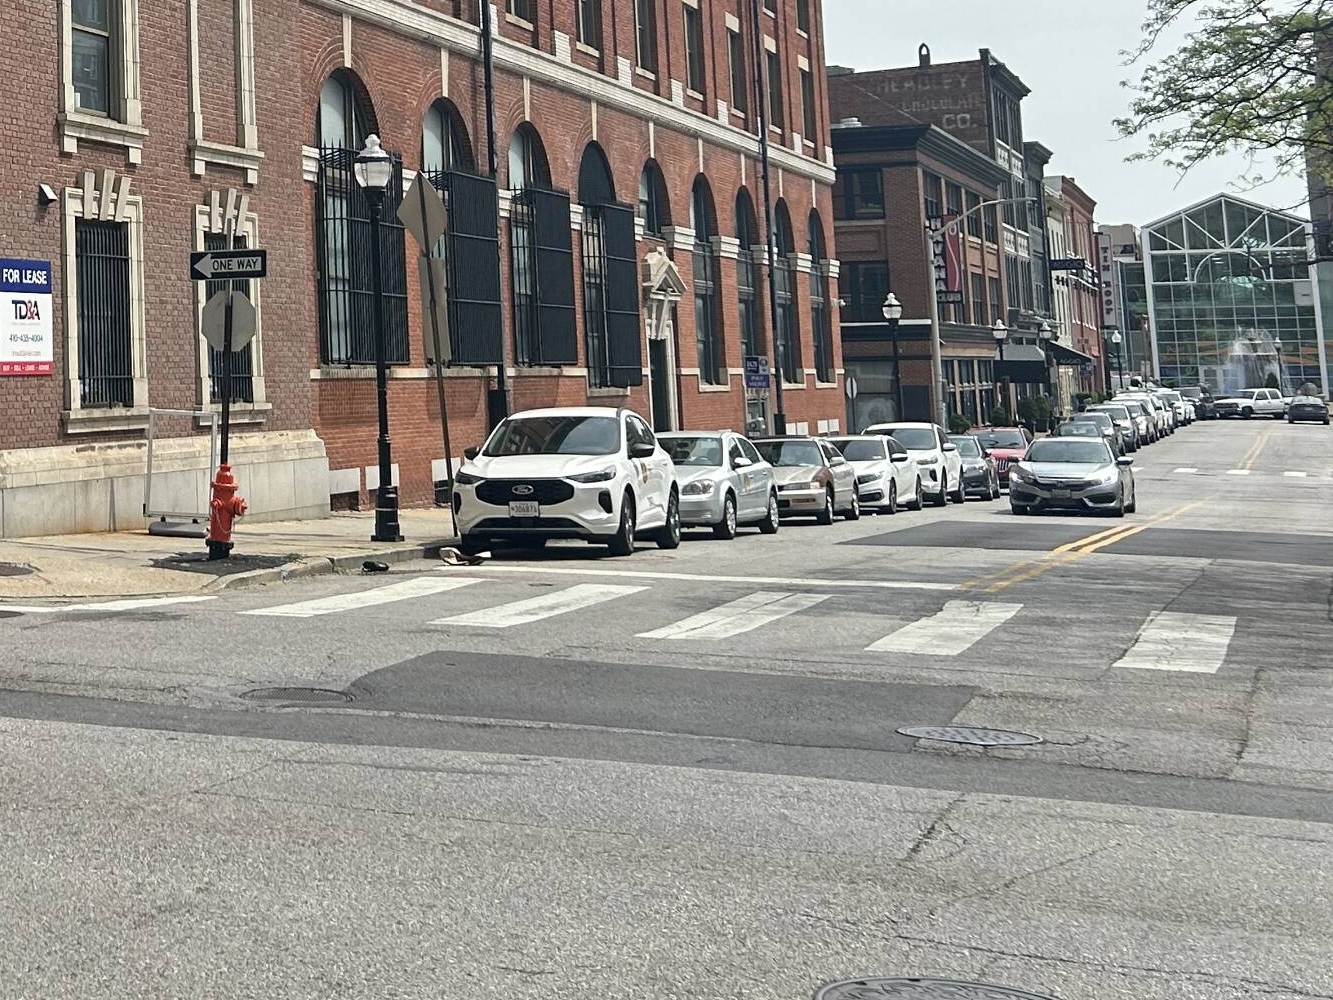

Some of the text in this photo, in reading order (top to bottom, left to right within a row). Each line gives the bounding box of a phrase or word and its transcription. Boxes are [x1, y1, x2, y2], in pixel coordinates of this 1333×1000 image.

[942, 113, 977, 129] CO.
[212, 258, 259, 271] ONE WAY
[1100, 246, 1111, 272] TIN
[2, 268, 48, 285] FOR LEASE
[11, 299, 41, 321] TD&A
